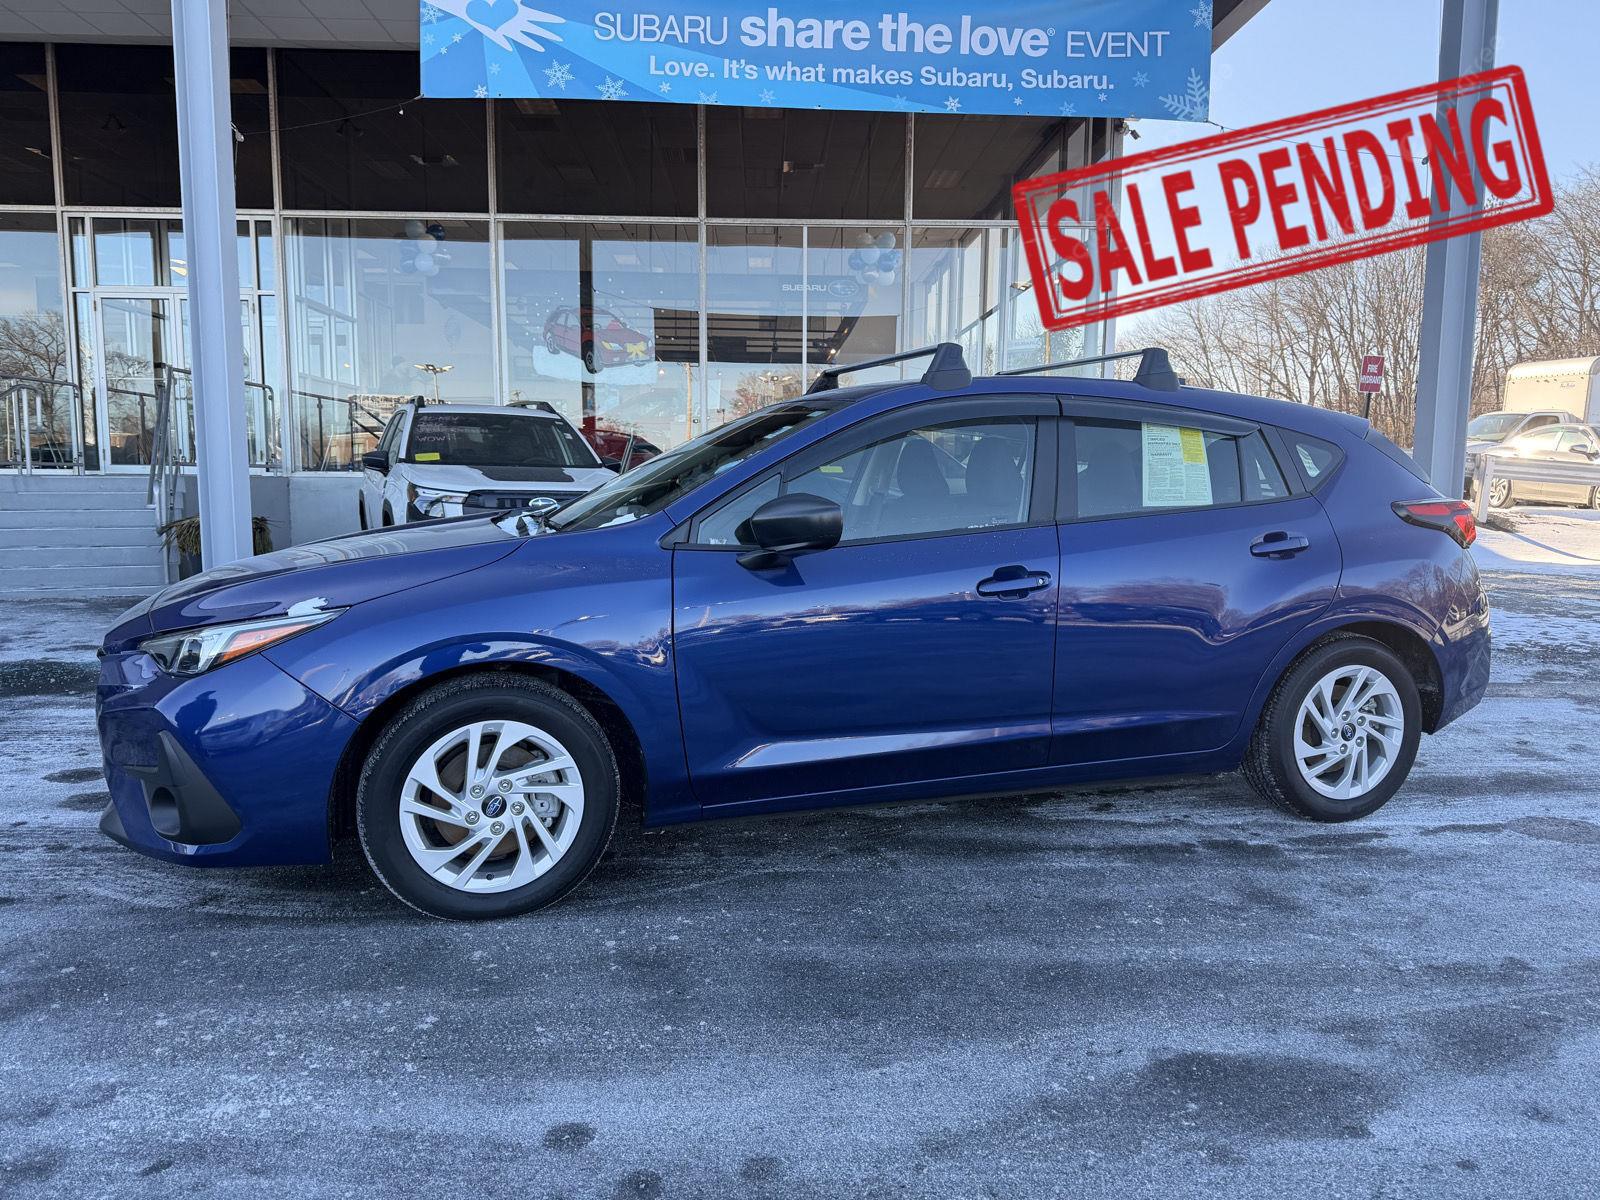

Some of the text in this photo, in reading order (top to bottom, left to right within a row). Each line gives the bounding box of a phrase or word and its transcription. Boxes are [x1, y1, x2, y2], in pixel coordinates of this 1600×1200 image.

[594, 12, 728, 45] SUBARU
[740, 7, 870, 49] share
[879, 12, 952, 53] the
[1066, 31, 1170, 58] EVENT
[649, 55, 1115, 91] Love. It's what makes Subaru, Subaru.
